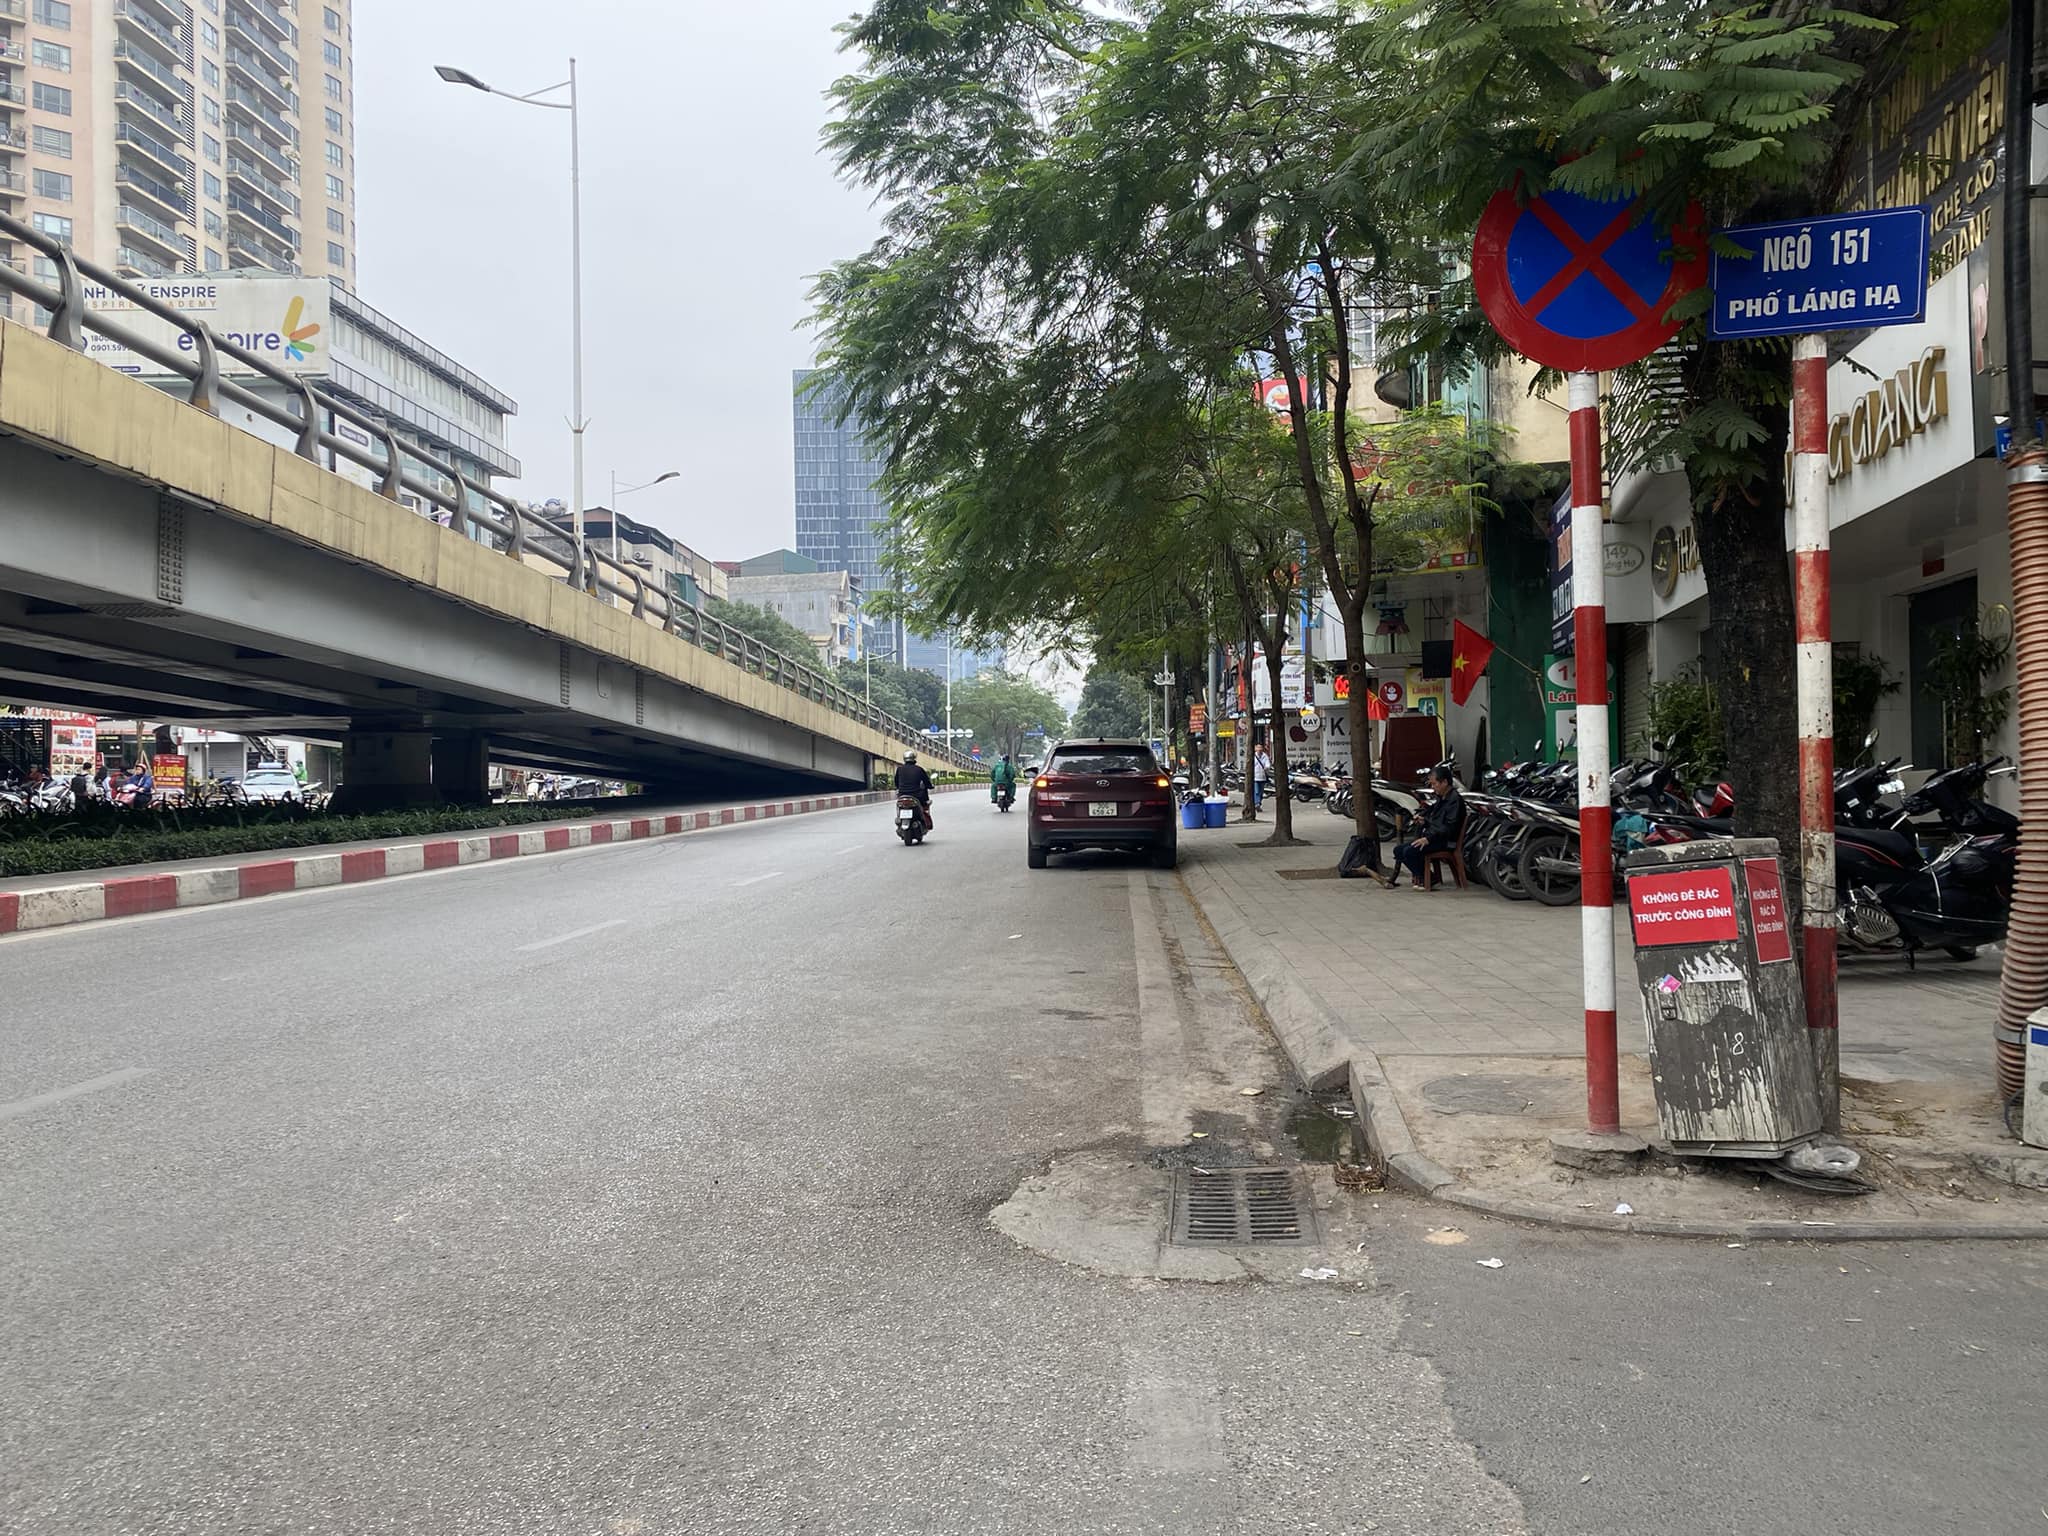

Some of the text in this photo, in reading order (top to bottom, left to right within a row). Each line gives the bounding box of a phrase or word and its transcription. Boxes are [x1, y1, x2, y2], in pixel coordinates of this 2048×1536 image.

[1763, 227, 1870, 273] NGÕ 151
[150, 286, 217, 298] ENSPIRE
[1728, 284, 1901, 319] PHỐ LÁNG HẠ
[1606, 546, 1629, 559] 149
[1548, 690, 1576, 703] Lán
[1642, 890, 1679, 904] KHÔNG
[1697, 887, 1719, 899] RÁC
[1636, 908, 1673, 923] TRƯỚC
[1706, 905, 1732, 918] ĐÌNH
